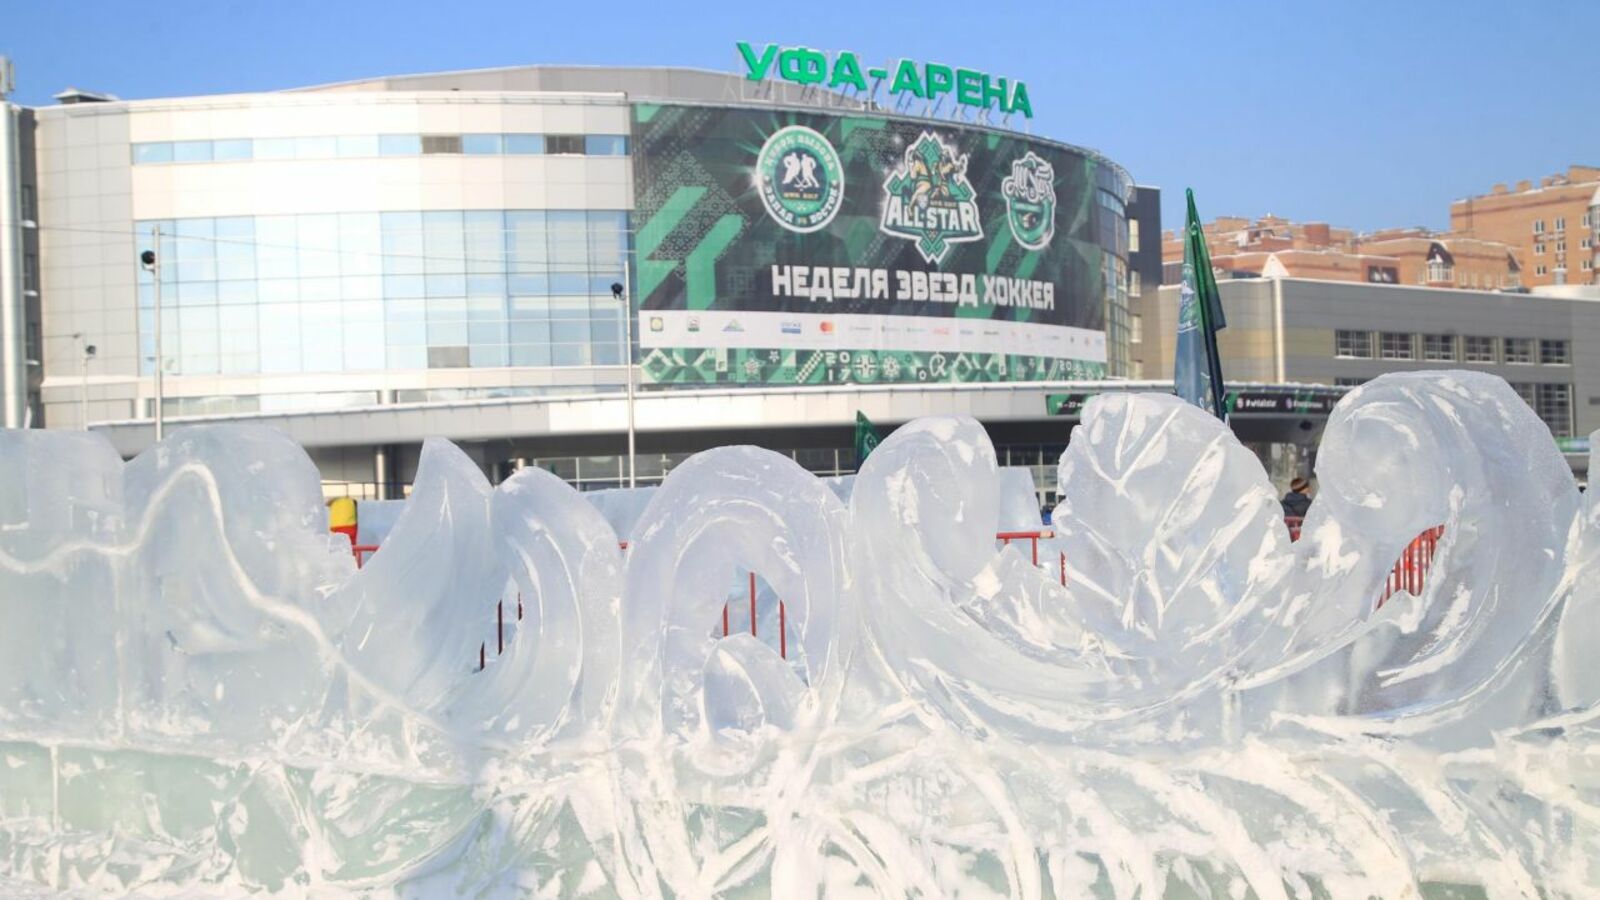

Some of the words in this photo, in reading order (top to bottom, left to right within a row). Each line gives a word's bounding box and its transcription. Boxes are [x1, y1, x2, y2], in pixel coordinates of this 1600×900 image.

[736, 40, 1034, 118] УФА-АРЕНА
[771, 264, 889, 302] НЕДЕЛЯ
[895, 269, 978, 308] ЗВЕЗД
[982, 275, 1055, 311] ХОККЕЯ
